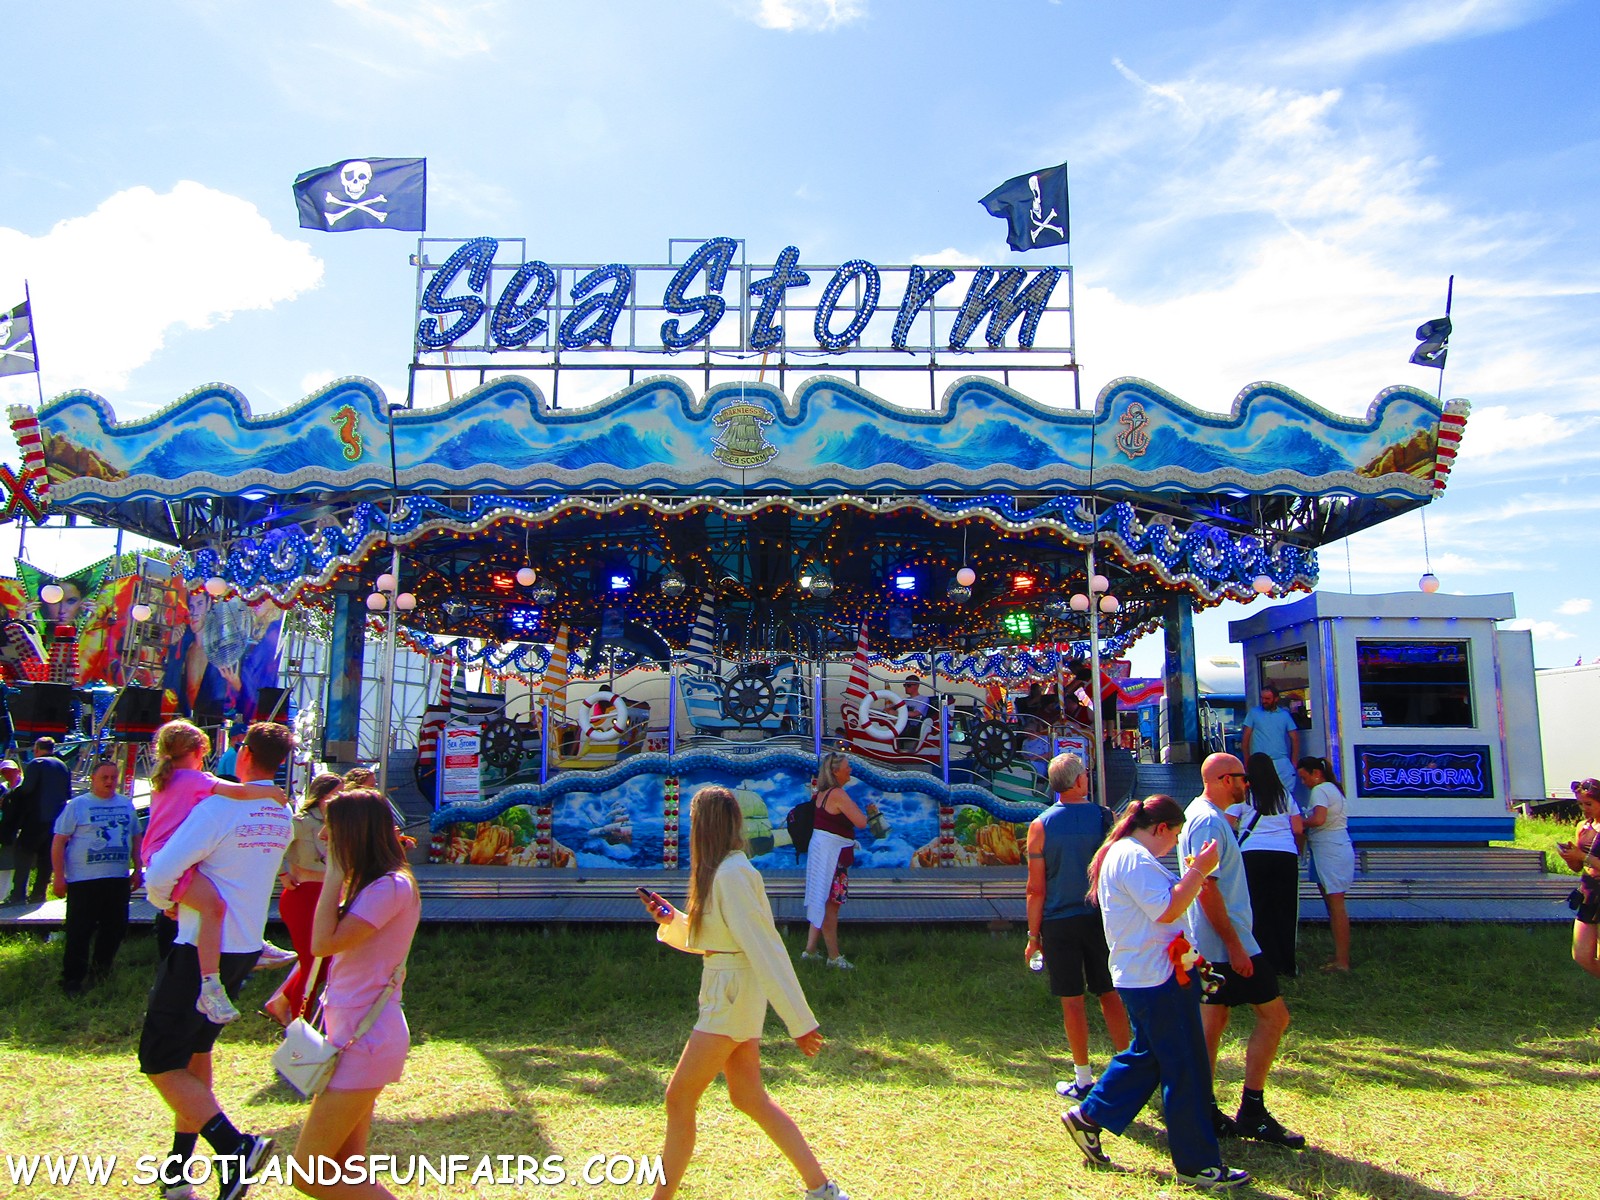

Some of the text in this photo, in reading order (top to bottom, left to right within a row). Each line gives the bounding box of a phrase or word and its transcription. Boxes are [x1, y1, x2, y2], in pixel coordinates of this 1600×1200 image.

[416, 236, 1063, 351] Sea Storm
[741, 454, 767, 464] STORM
[1369, 768, 1475, 785] SEASTORM
